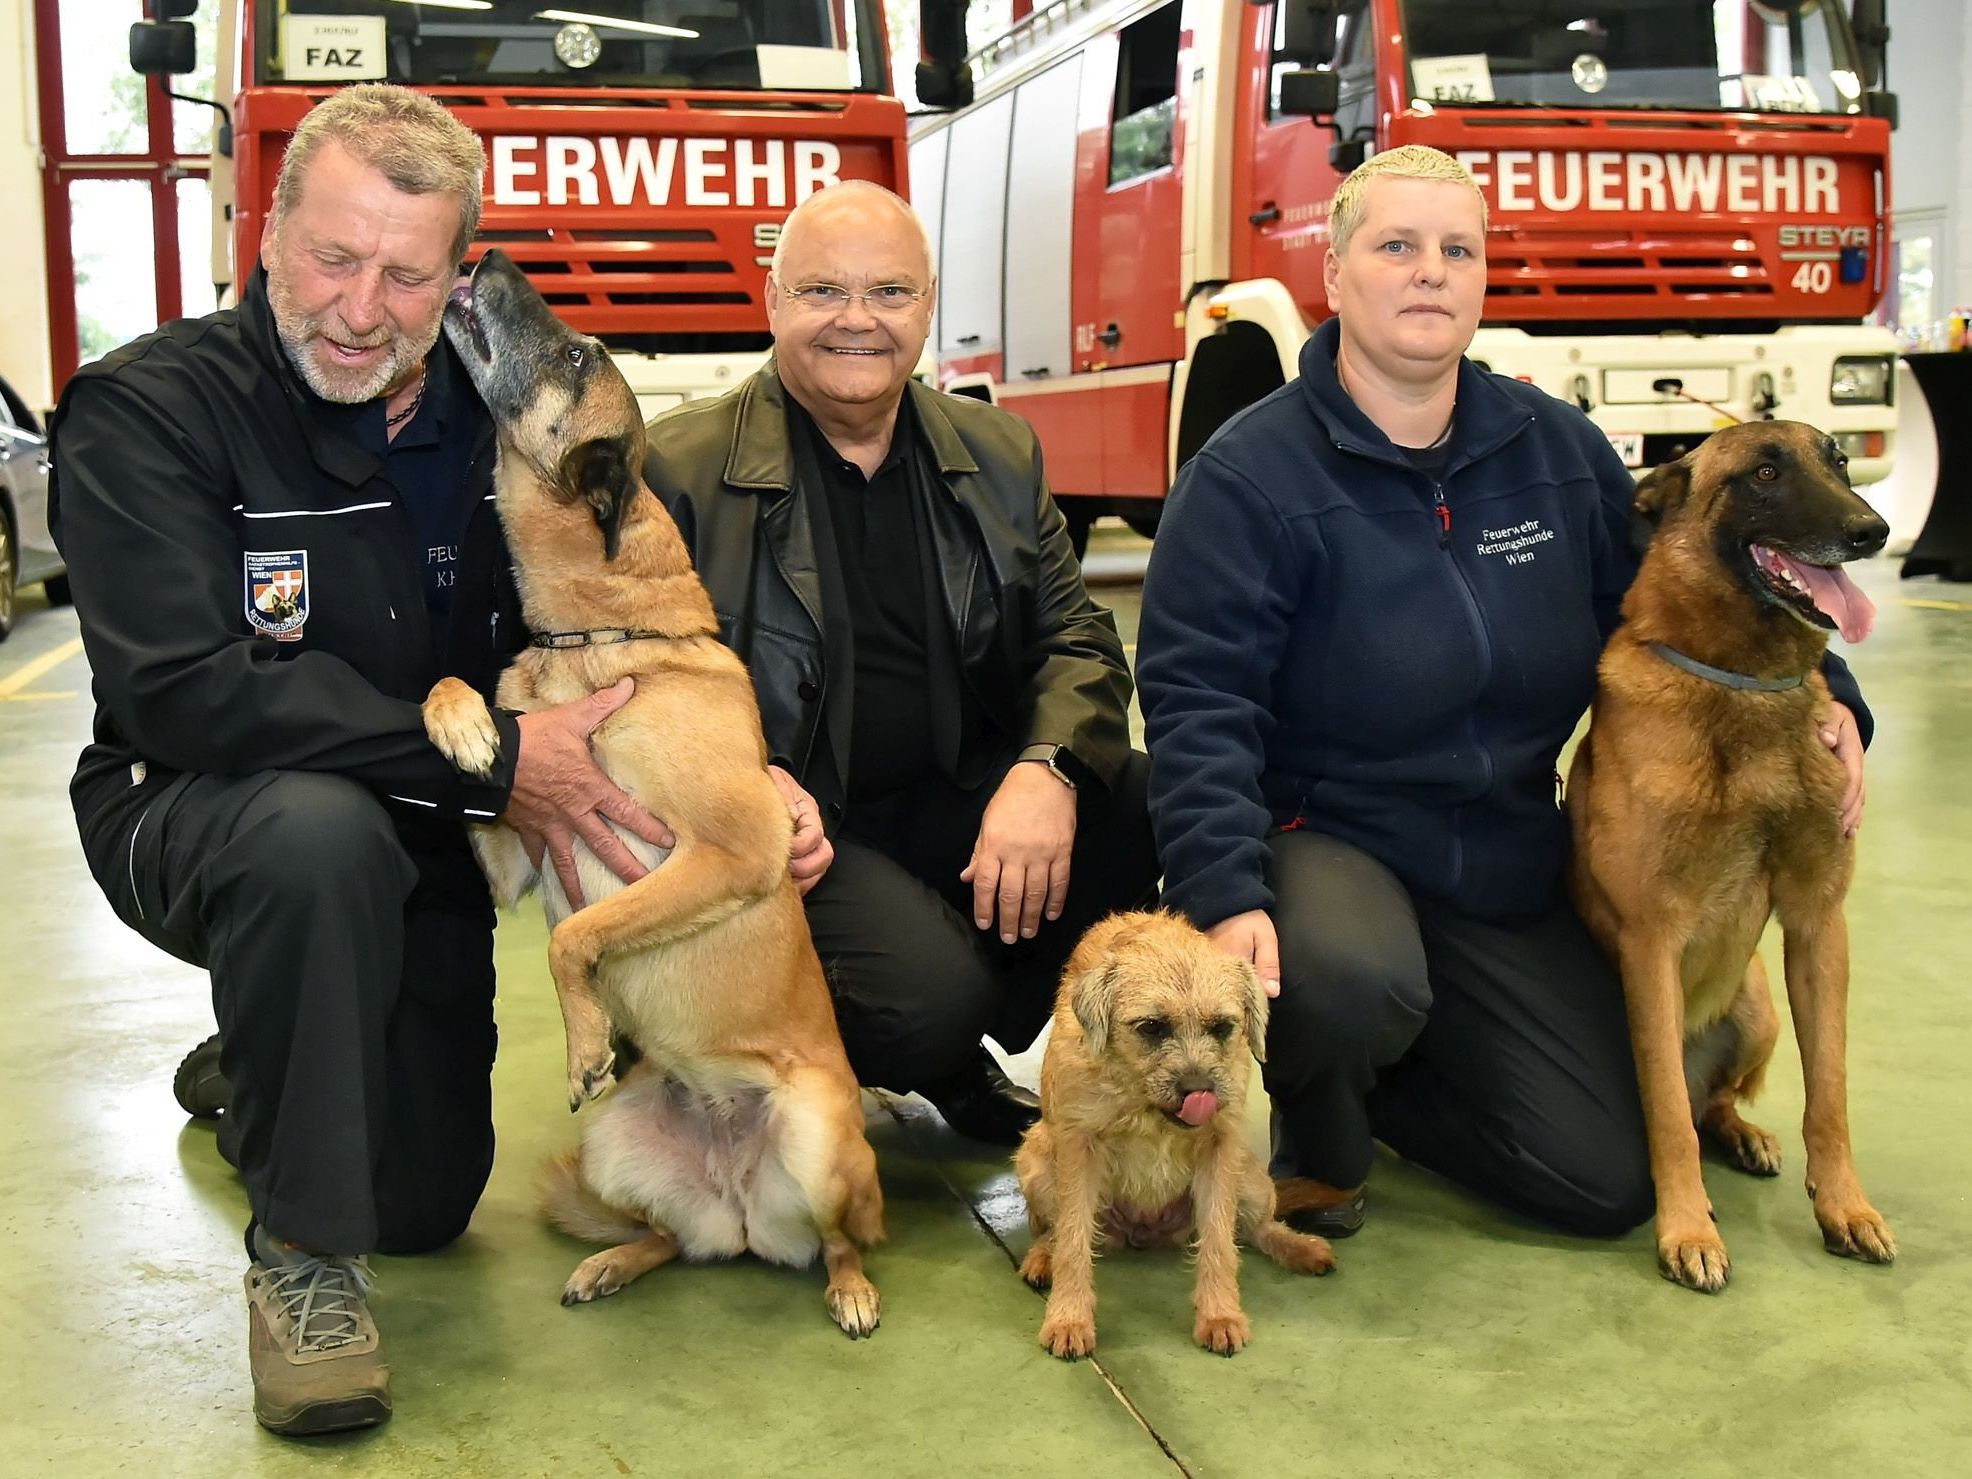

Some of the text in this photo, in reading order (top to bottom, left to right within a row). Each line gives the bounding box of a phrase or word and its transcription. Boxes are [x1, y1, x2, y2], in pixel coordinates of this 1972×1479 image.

[305, 47, 364, 68] FAZ
[1778, 224, 1869, 247] STEYR
[1790, 261, 1832, 294] 40
[1477, 529, 1554, 555] Rettungshunde
[1482, 520, 1540, 541] Feuerwehr
[1505, 551, 1536, 566] Wien
[249, 607, 305, 631] RETTUNGSHUNDE
